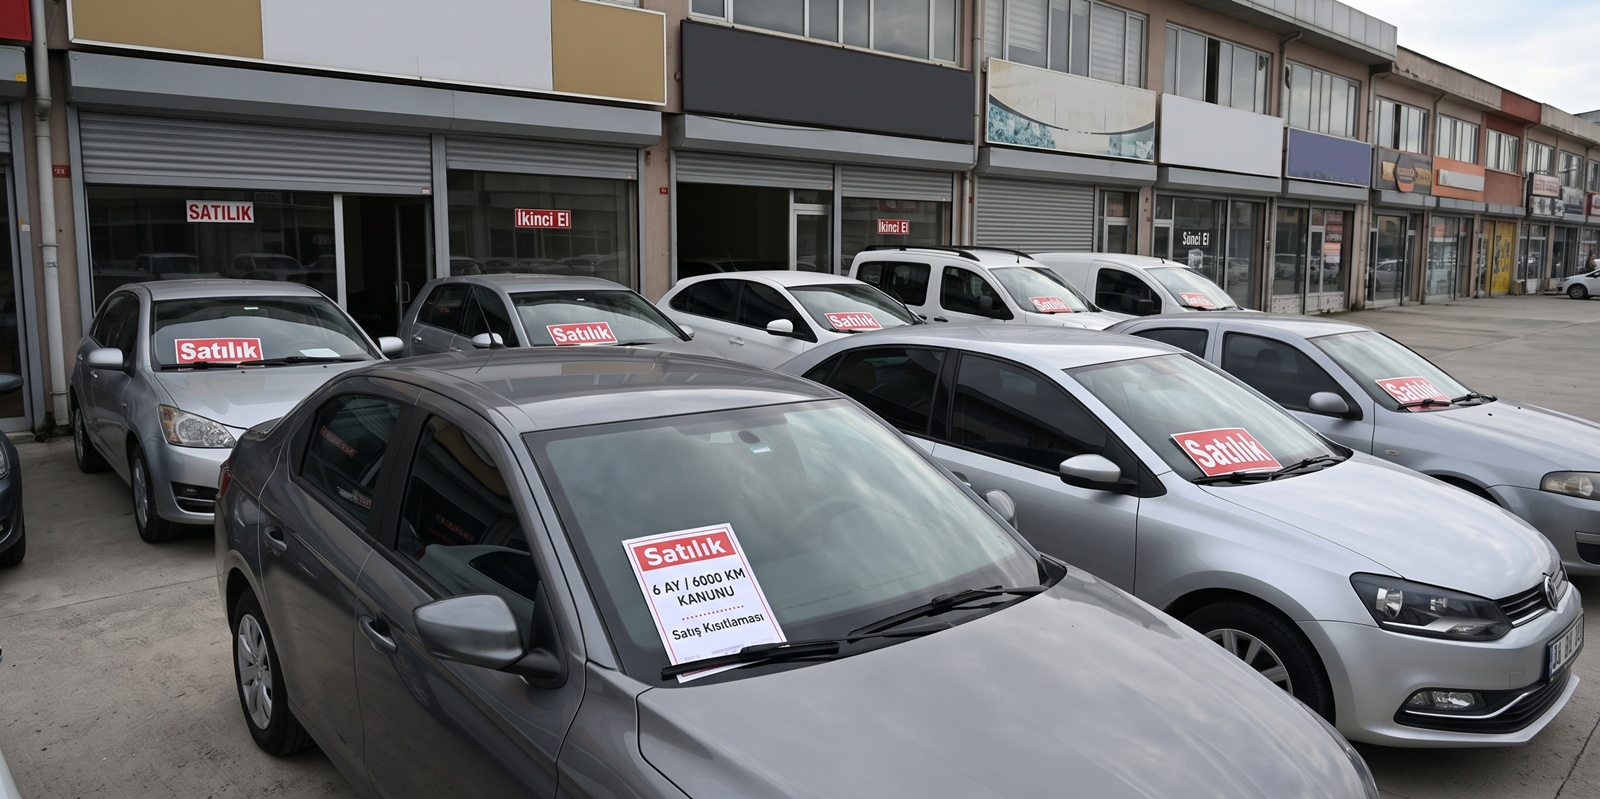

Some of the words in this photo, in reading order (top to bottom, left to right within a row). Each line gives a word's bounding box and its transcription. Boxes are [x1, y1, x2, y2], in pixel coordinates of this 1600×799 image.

[189, 203, 252, 221] SATILIK
[518, 209, 553, 226] İkinci
[558, 212, 569, 227] El
[829, 314, 878, 328] Satılık
[552, 325, 613, 342] Satılık
[180, 341, 258, 360] Satılık
[1184, 432, 1272, 468] Satılık
[643, 537, 727, 566] Satılık
[652, 584, 661, 596] 6
[664, 579, 681, 594] AY
[692, 572, 722, 588] 6000
[724, 567, 746, 582] KM
[677, 585, 735, 607] KANUNU
[672, 627, 702, 640] Satış
[702, 613, 765, 634] Kısıtlaması
